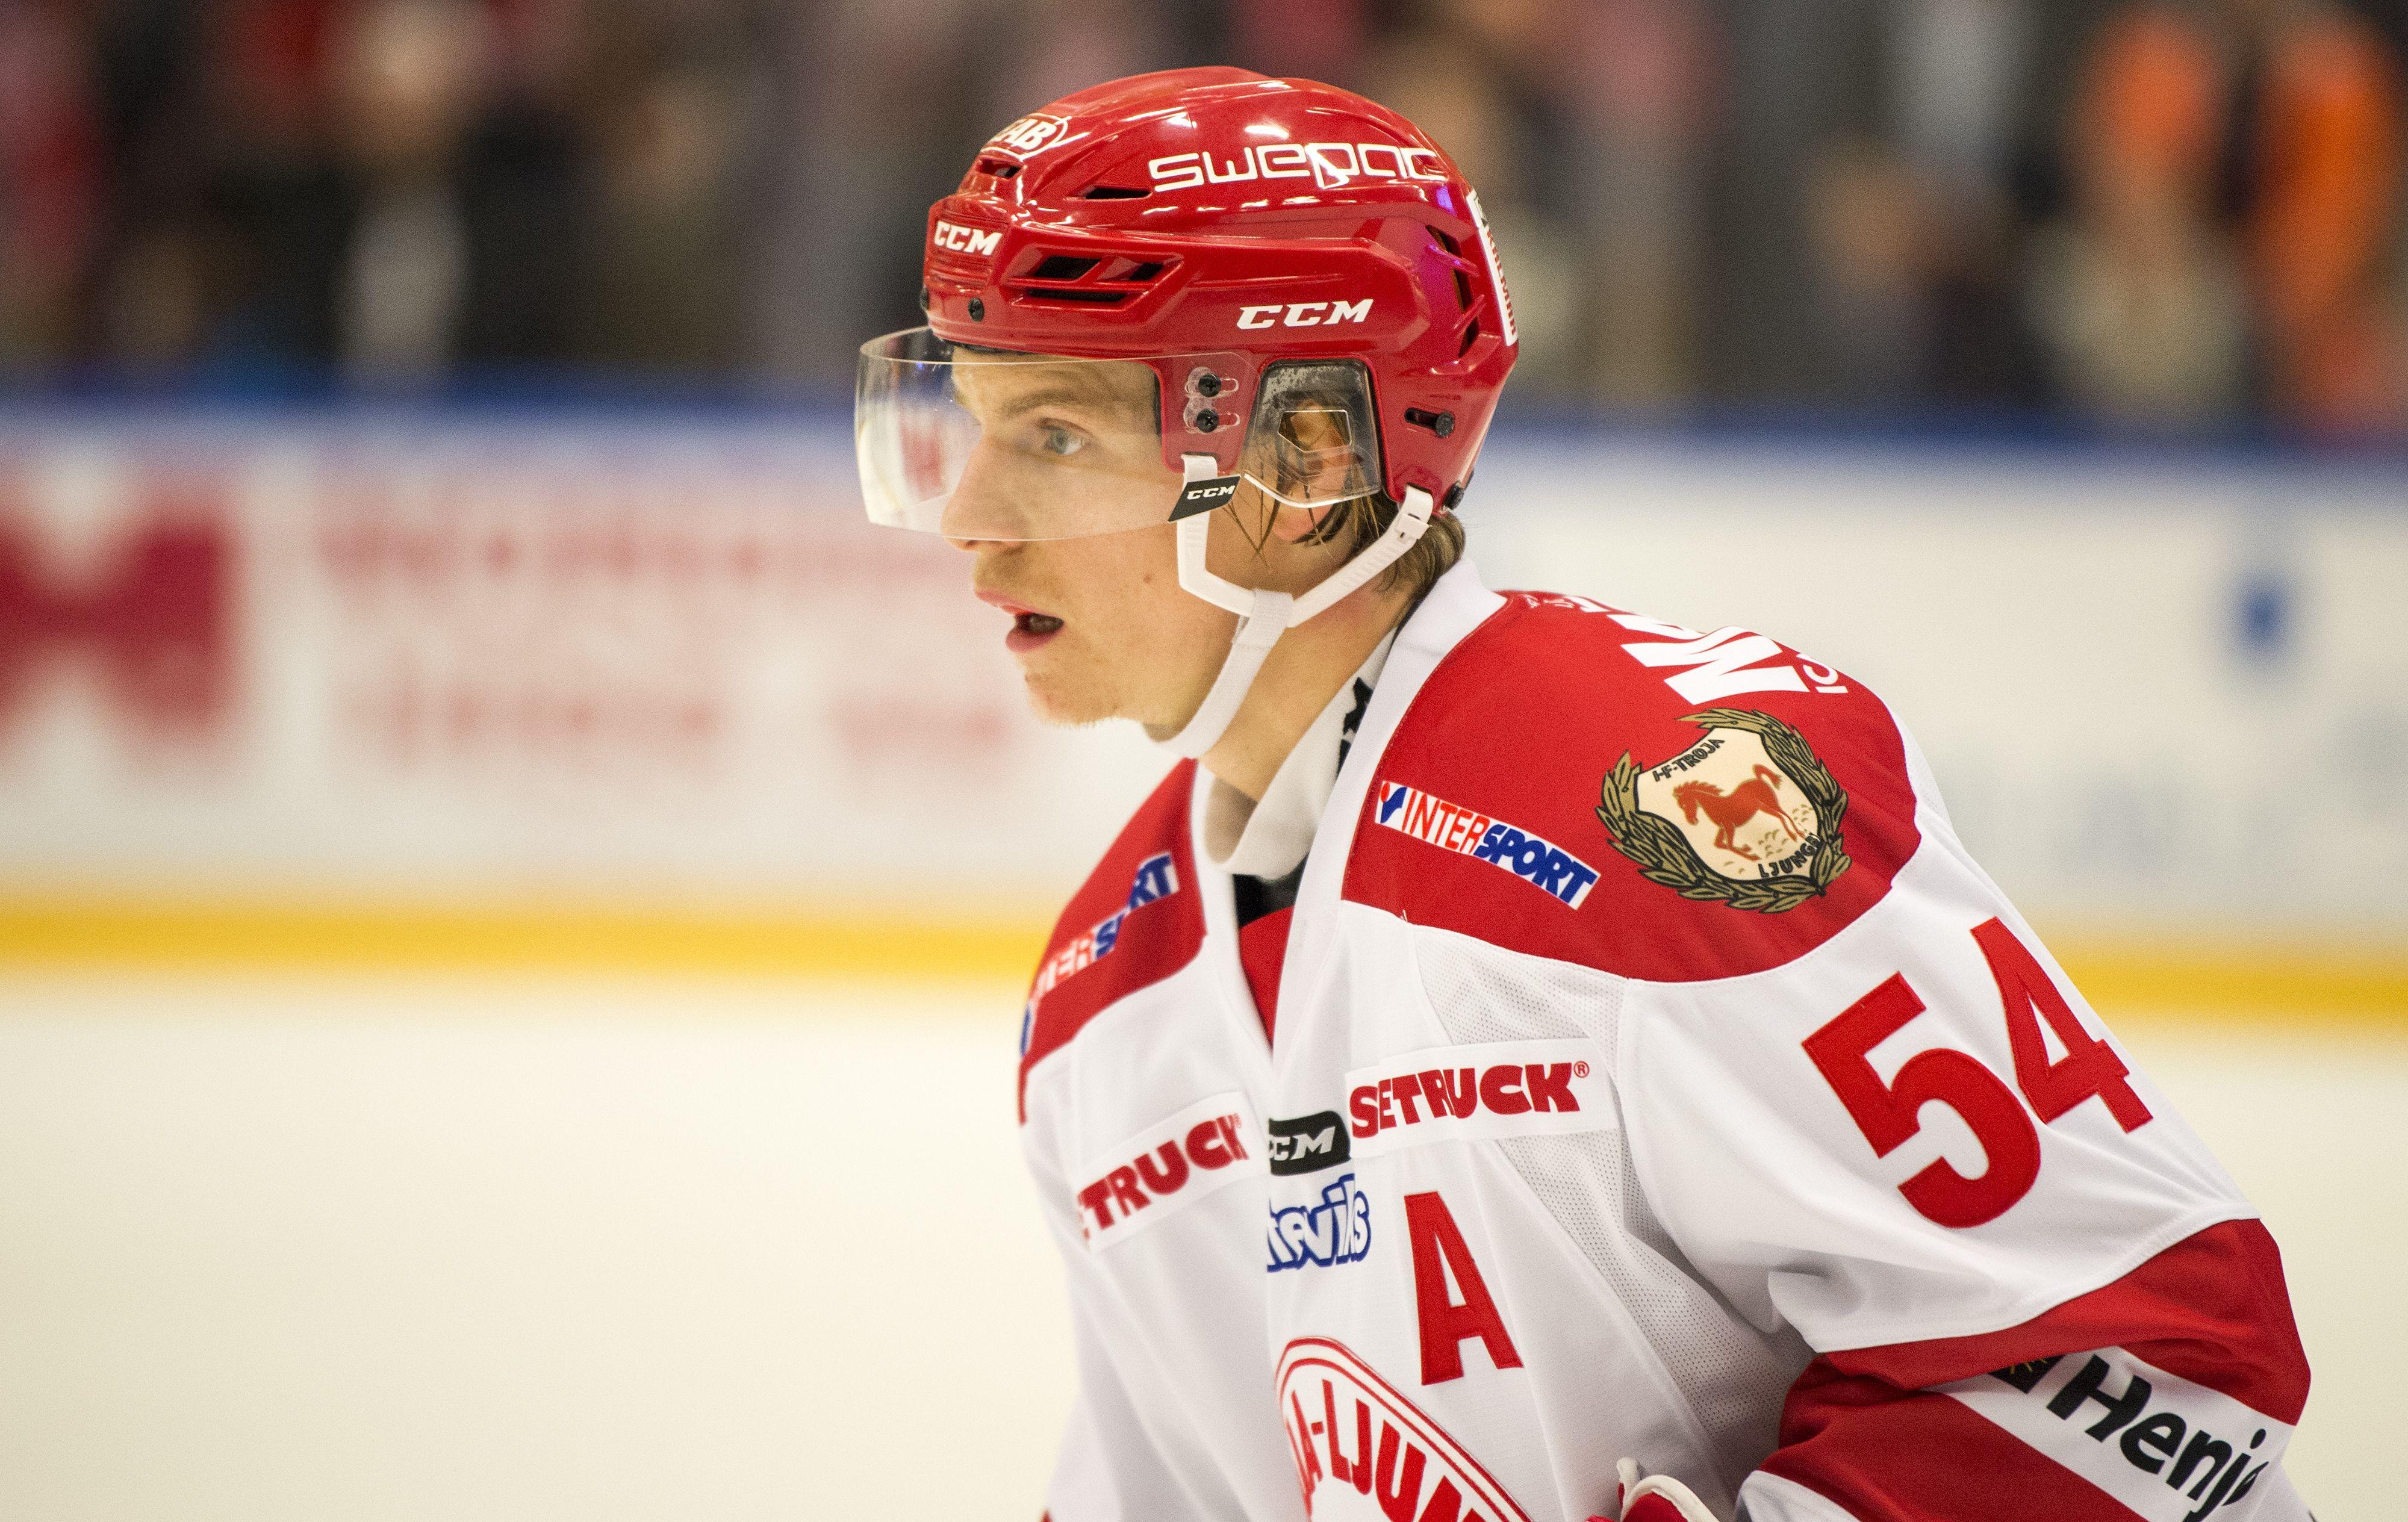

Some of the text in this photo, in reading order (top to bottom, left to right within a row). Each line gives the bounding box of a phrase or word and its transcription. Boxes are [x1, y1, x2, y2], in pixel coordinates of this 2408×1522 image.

[1148, 142, 1448, 193] swepac
[933, 220, 1004, 256] CCM
[1236, 298, 1374, 330] CCM
[1186, 485, 1236, 501] CCM
[1401, 789, 1594, 905] INTERSPORT
[1801, 916, 2154, 1229] 54
[1268, 1126, 1336, 1161] CM
[1404, 1190, 1525, 1386] A
